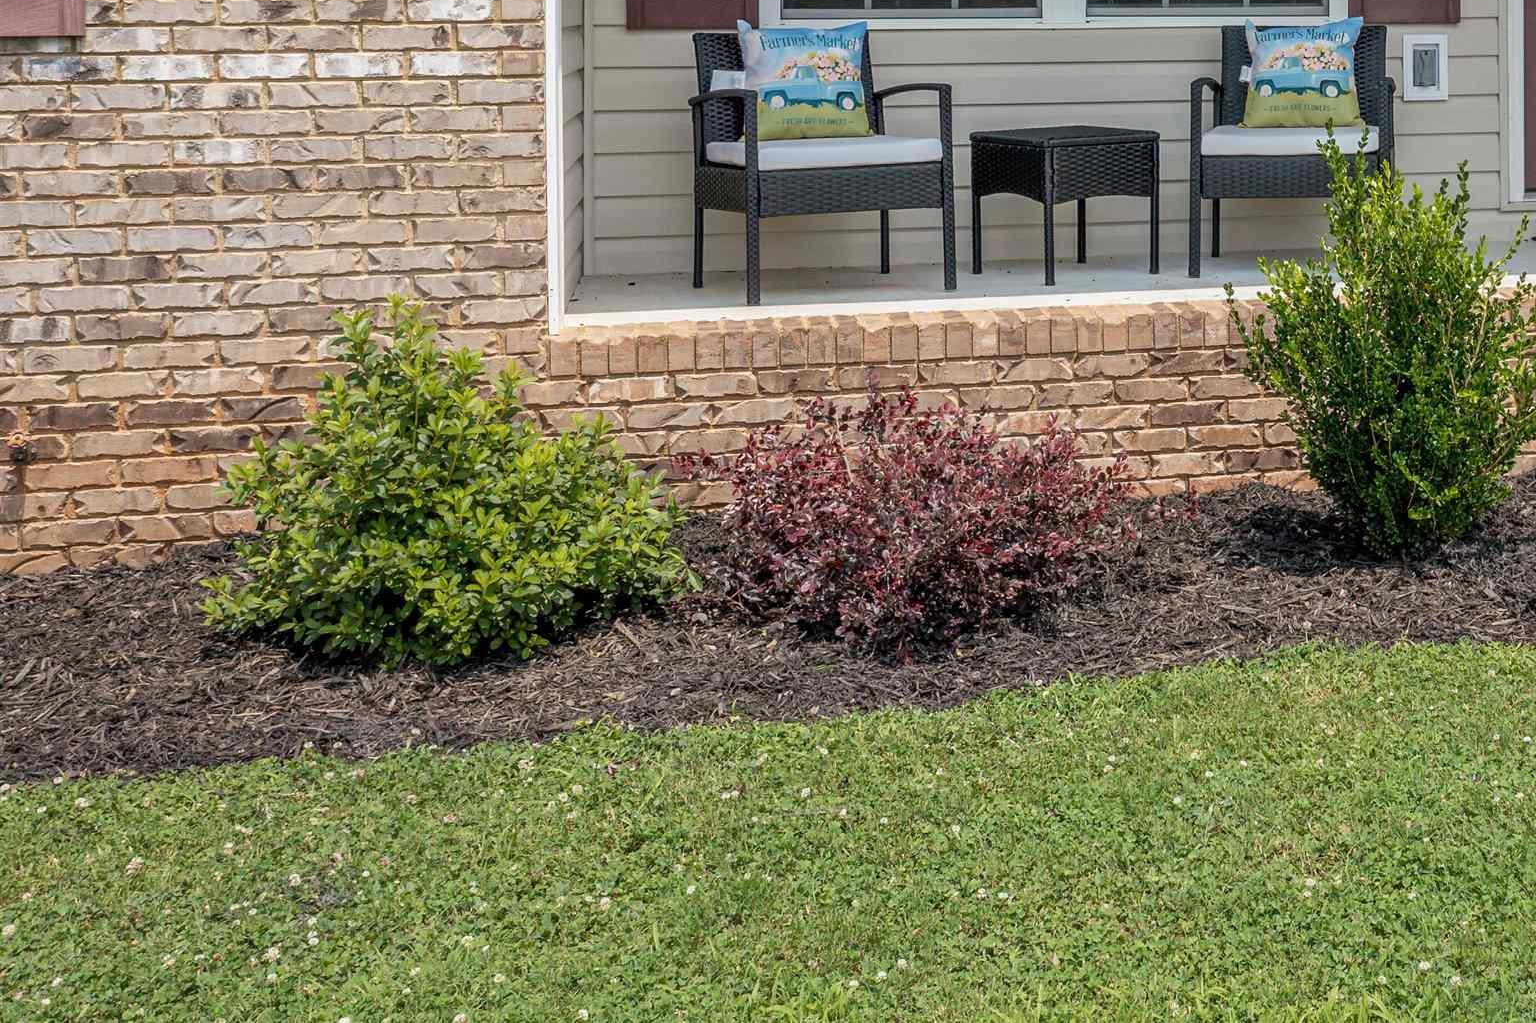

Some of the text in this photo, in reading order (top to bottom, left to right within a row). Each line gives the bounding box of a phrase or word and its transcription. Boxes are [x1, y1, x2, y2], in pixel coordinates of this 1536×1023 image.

[760, 34, 857, 51] Farmer's Market
[1306, 28, 1345, 43] Market
